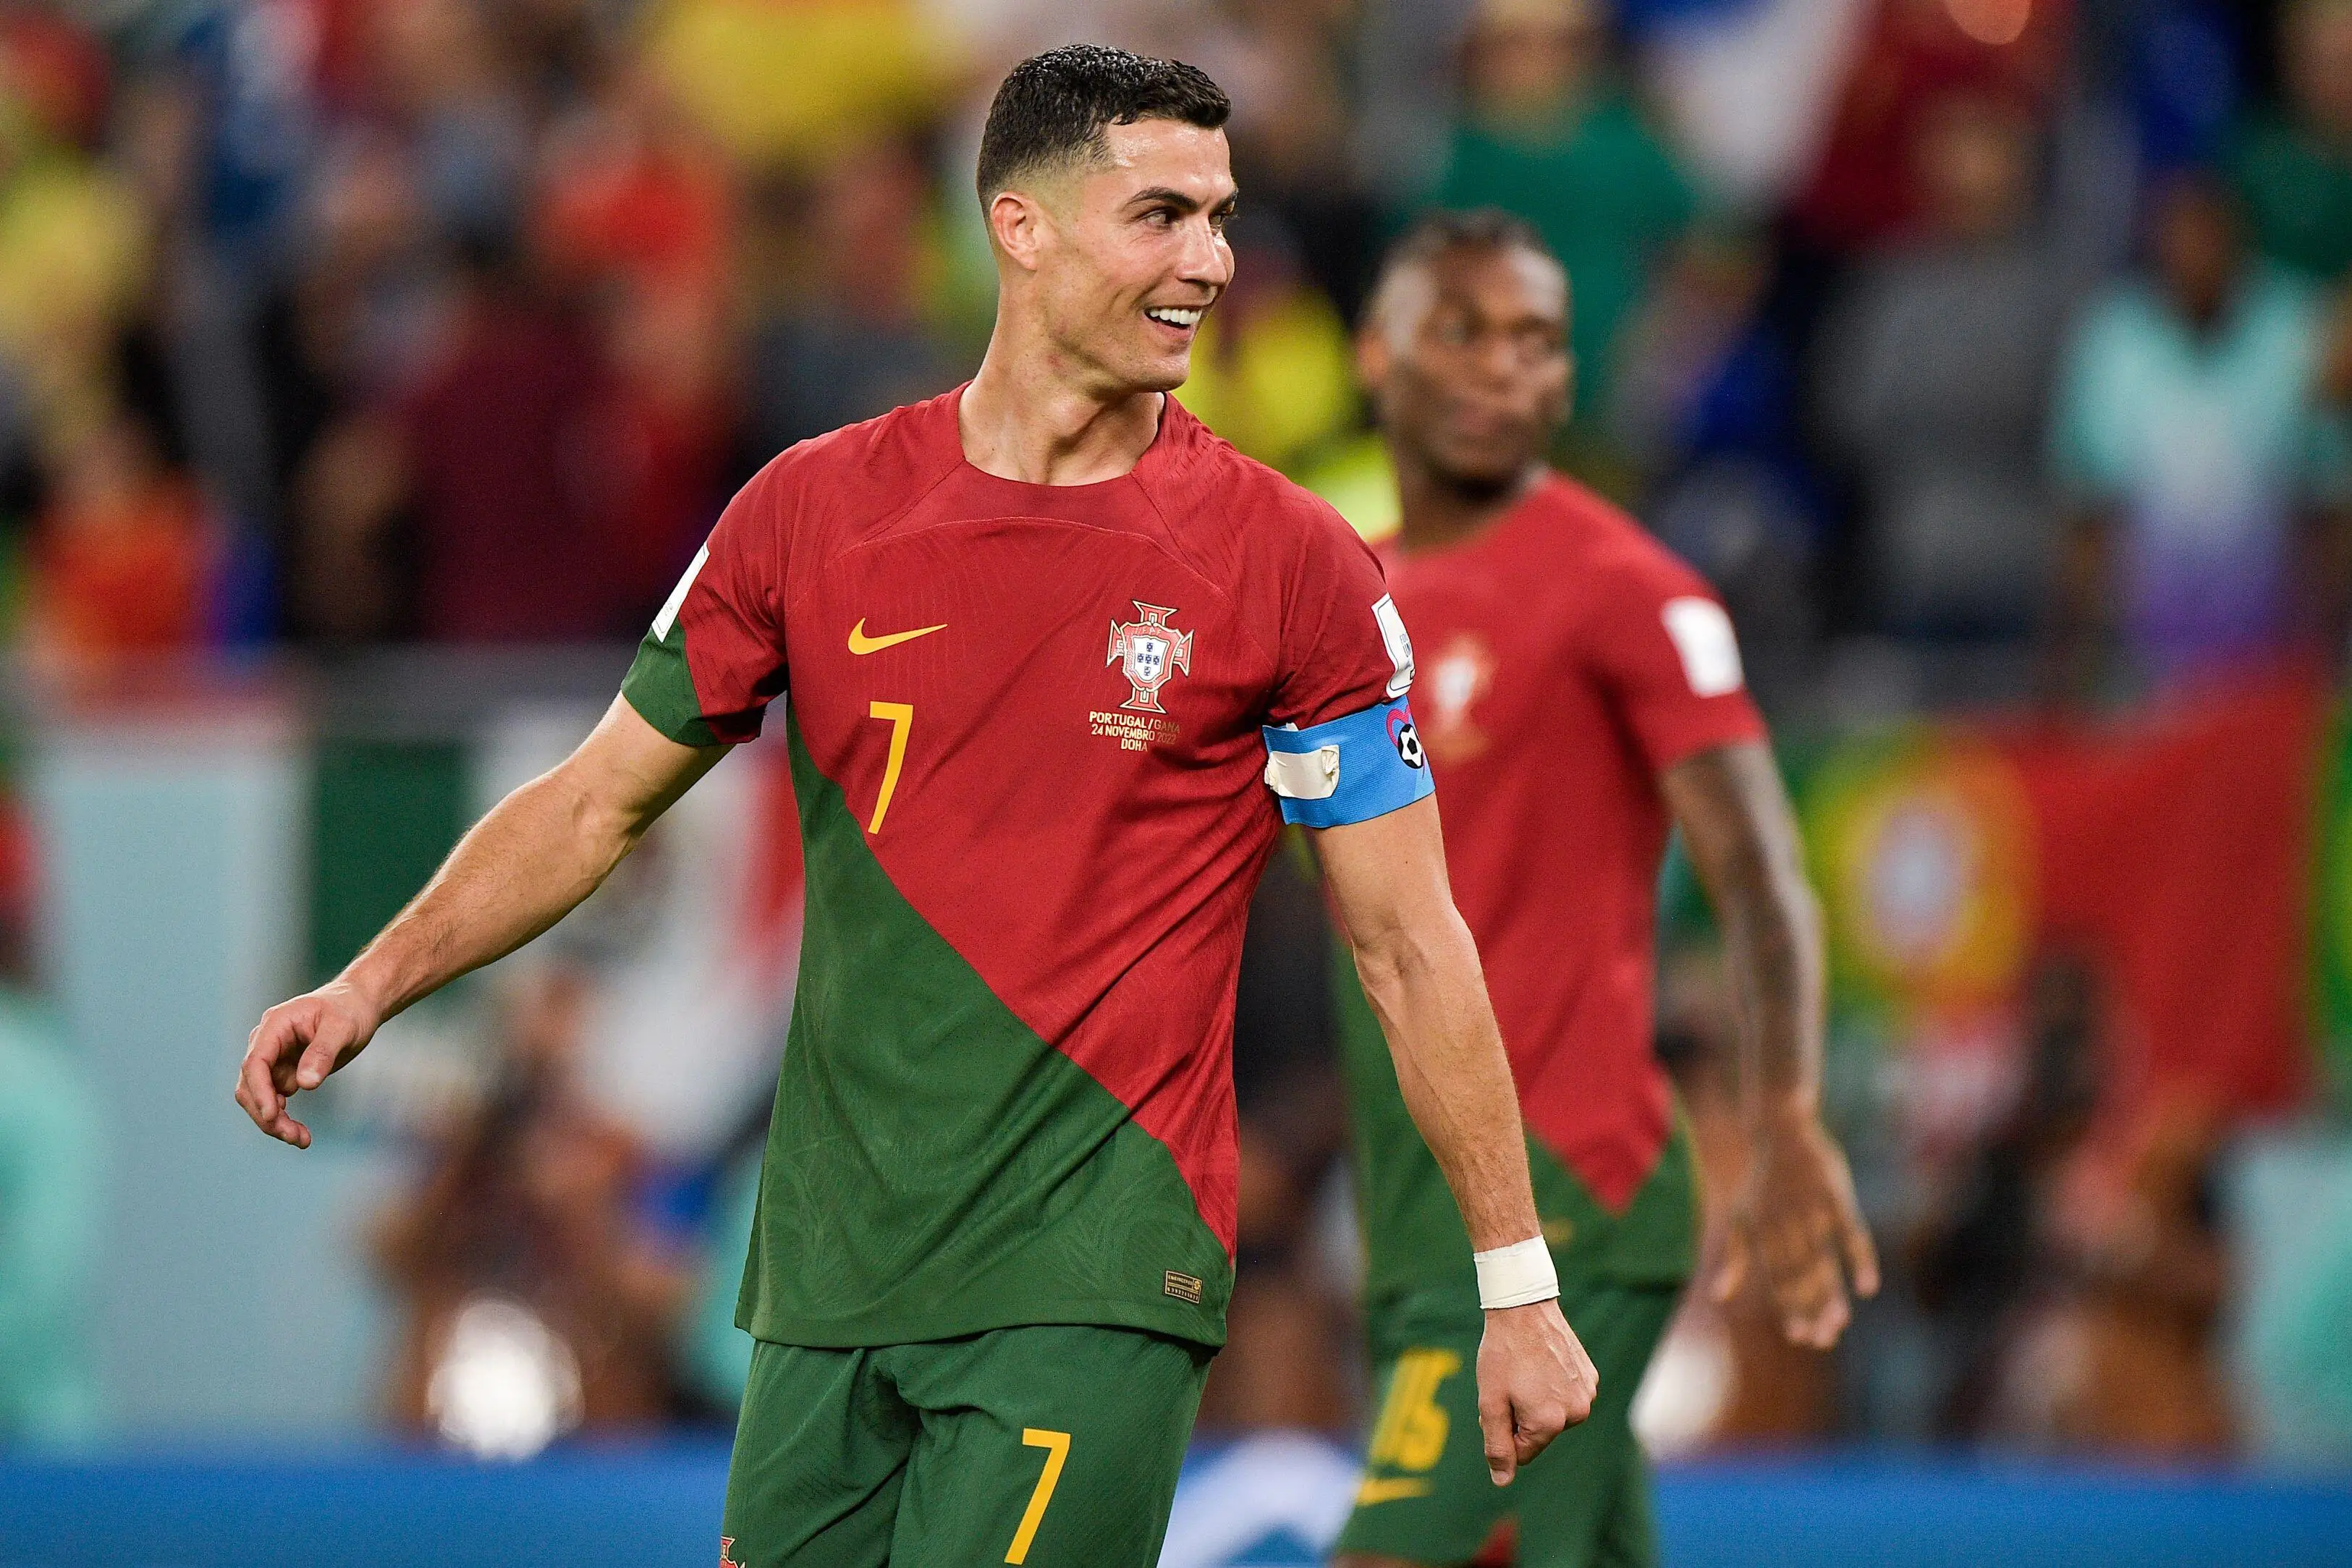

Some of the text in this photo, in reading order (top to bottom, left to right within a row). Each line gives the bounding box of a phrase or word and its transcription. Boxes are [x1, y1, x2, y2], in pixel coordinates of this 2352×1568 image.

[868, 701, 913, 834] 7
[1091, 724, 1176, 744] 24 NOVEMBRO 2022
[1121, 738, 1148, 752] DOHA
[1004, 1428, 1070, 1565] 7
